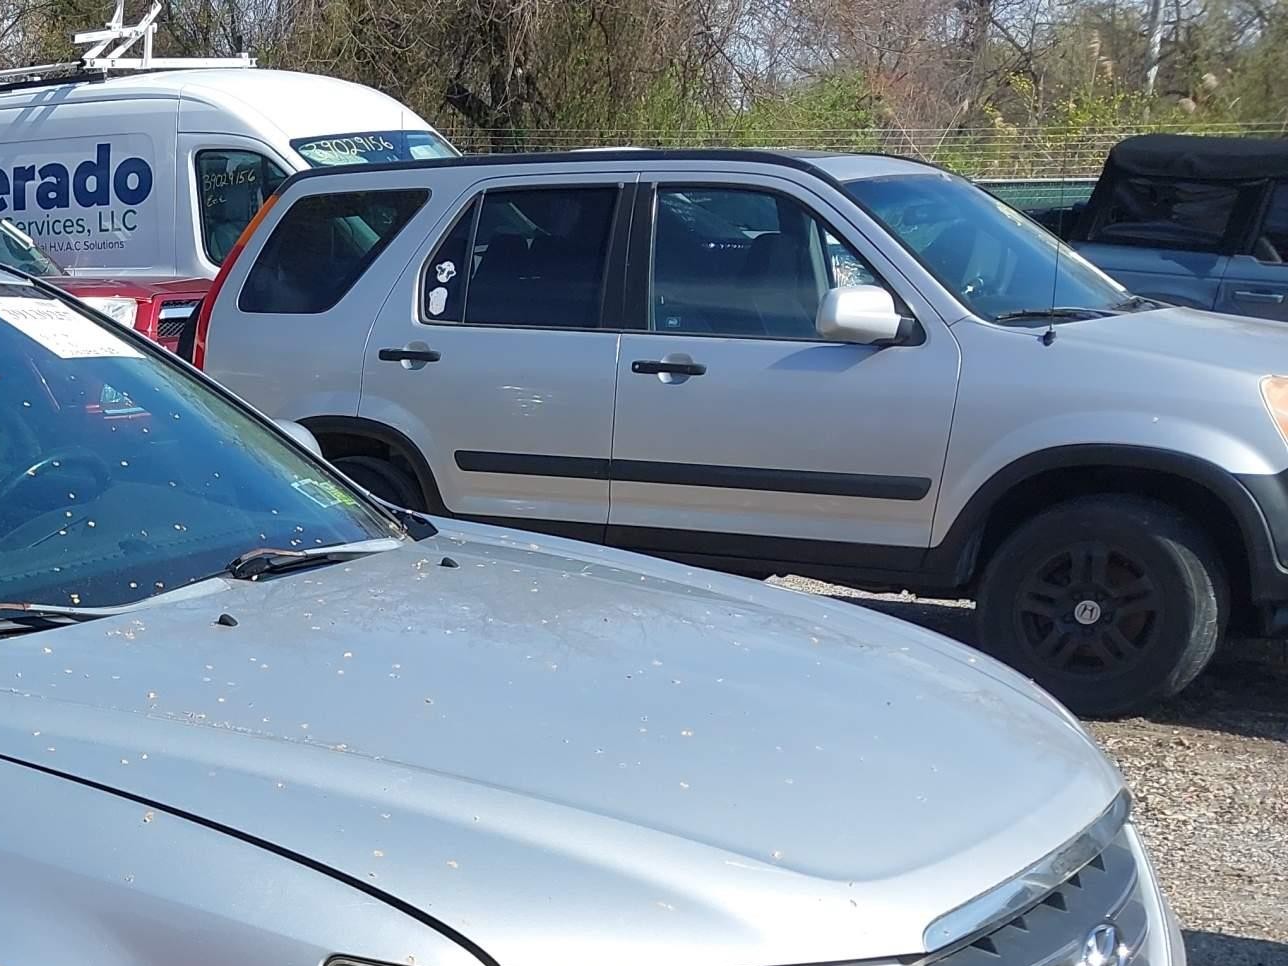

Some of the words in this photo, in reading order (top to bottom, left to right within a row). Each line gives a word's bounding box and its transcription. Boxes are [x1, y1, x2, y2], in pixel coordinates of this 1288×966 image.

[306, 135, 394, 160] 39029156
[98, 209, 138, 232] LLC
[83, 240, 125, 251] Solutions
